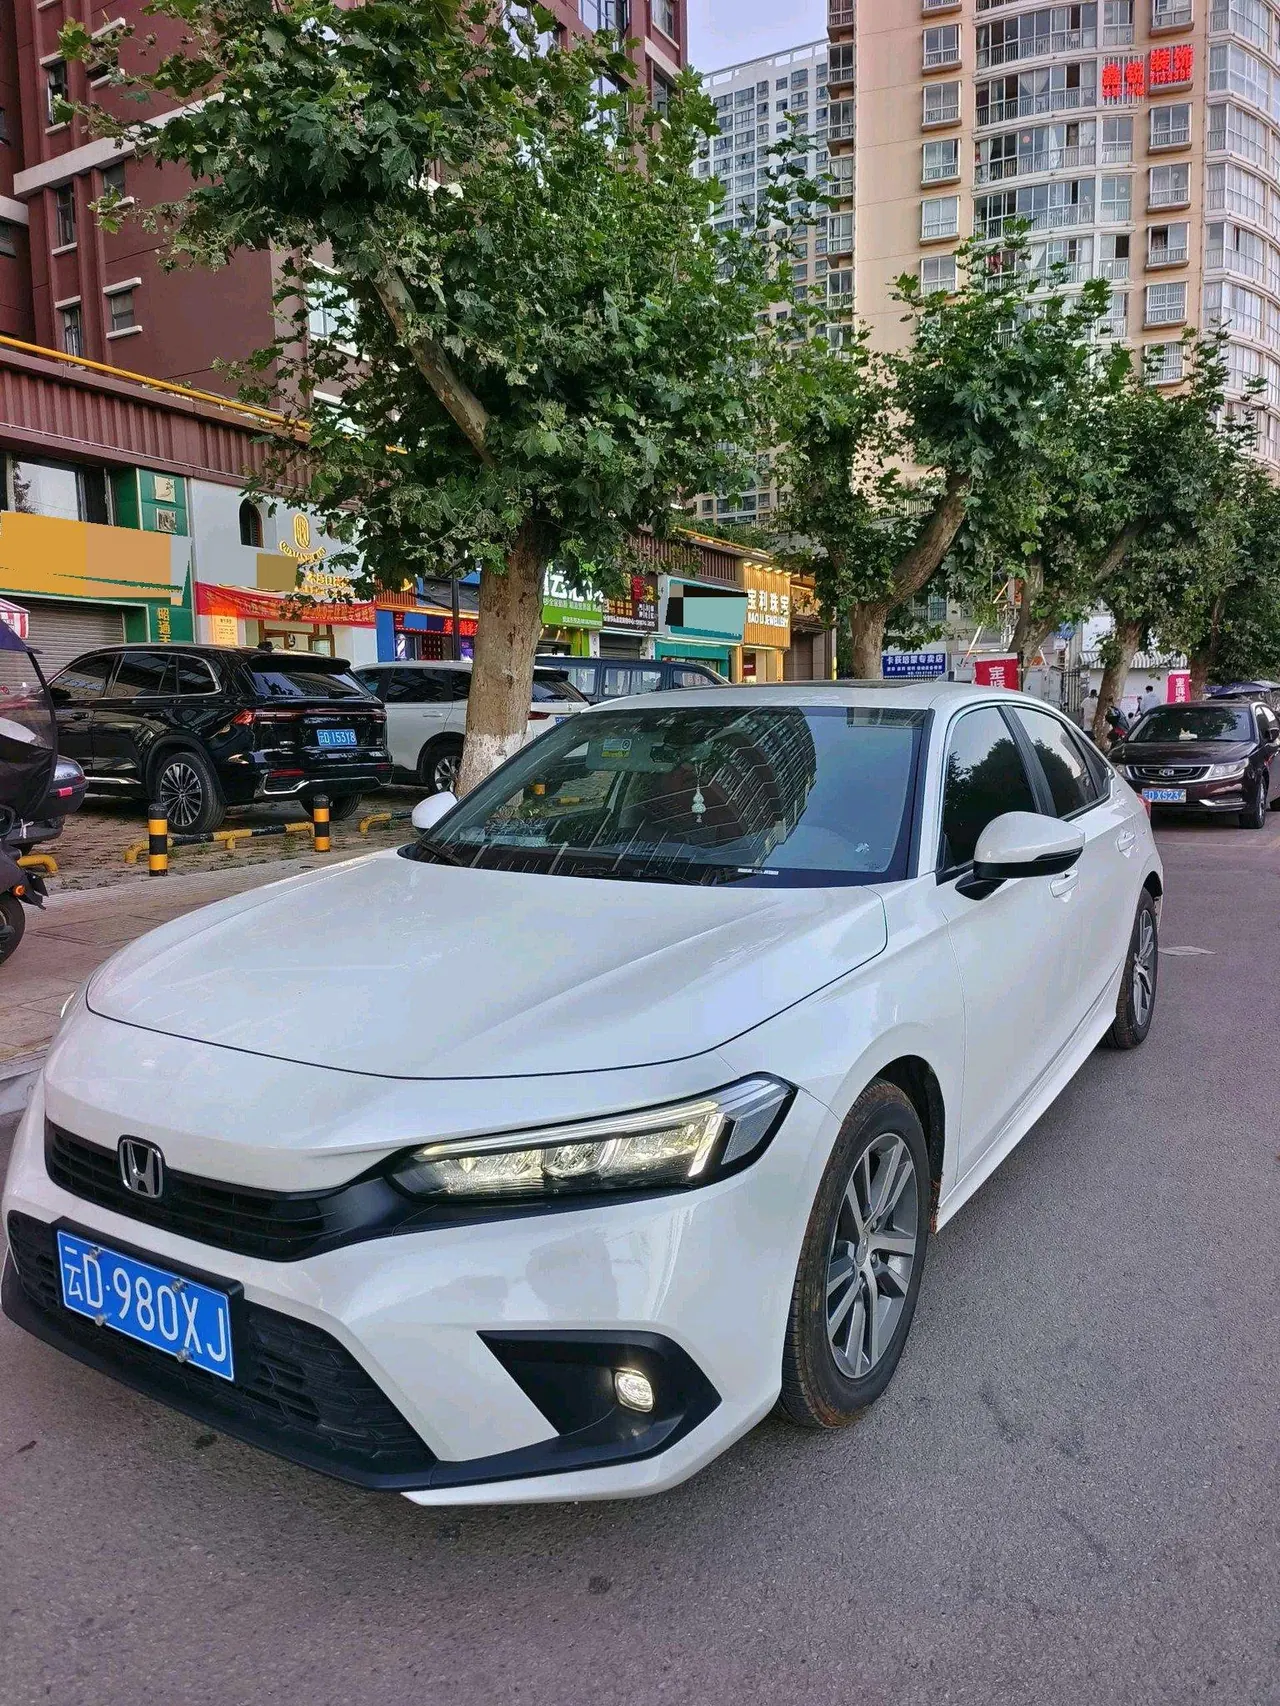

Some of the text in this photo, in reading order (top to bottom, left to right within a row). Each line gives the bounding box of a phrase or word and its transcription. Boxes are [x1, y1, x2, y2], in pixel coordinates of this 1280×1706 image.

[747, 588, 790, 615] 宝利珠宝
[64, 1246, 227, 1362] 云D·980XJ
